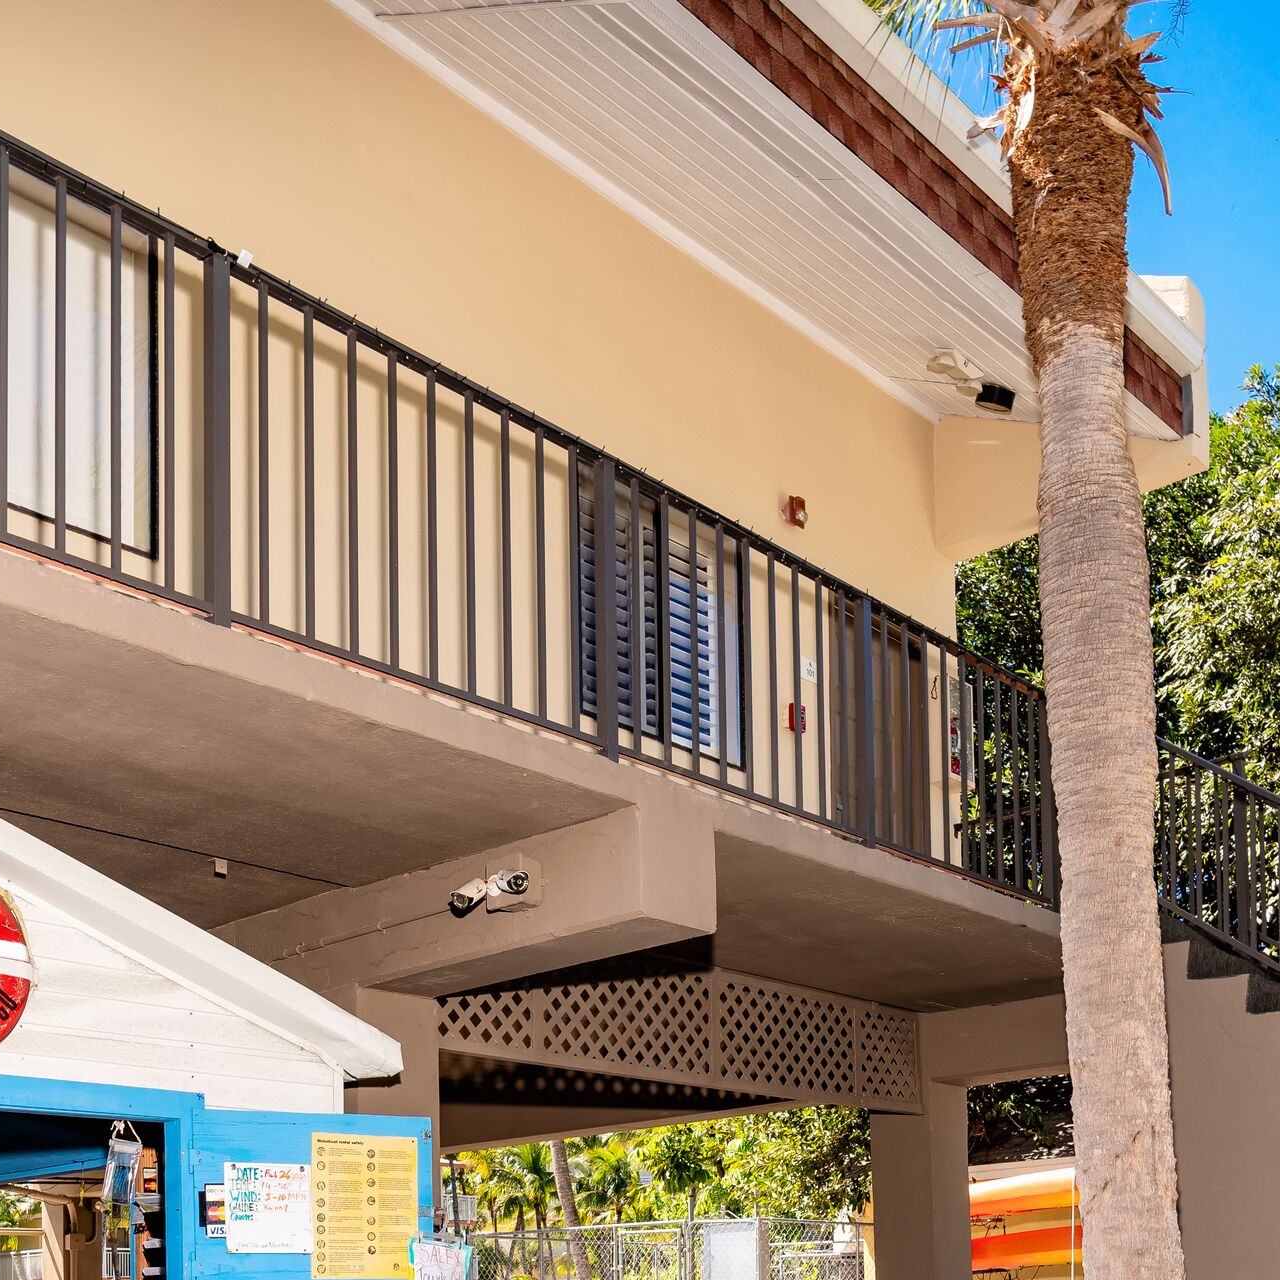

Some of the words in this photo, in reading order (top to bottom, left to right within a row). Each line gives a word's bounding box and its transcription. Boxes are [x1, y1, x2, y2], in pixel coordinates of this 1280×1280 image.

[235, 1167, 263, 1181] DATE:
[229, 1189, 261, 1203] WIND:
[210, 1226, 227, 1236] VIS
